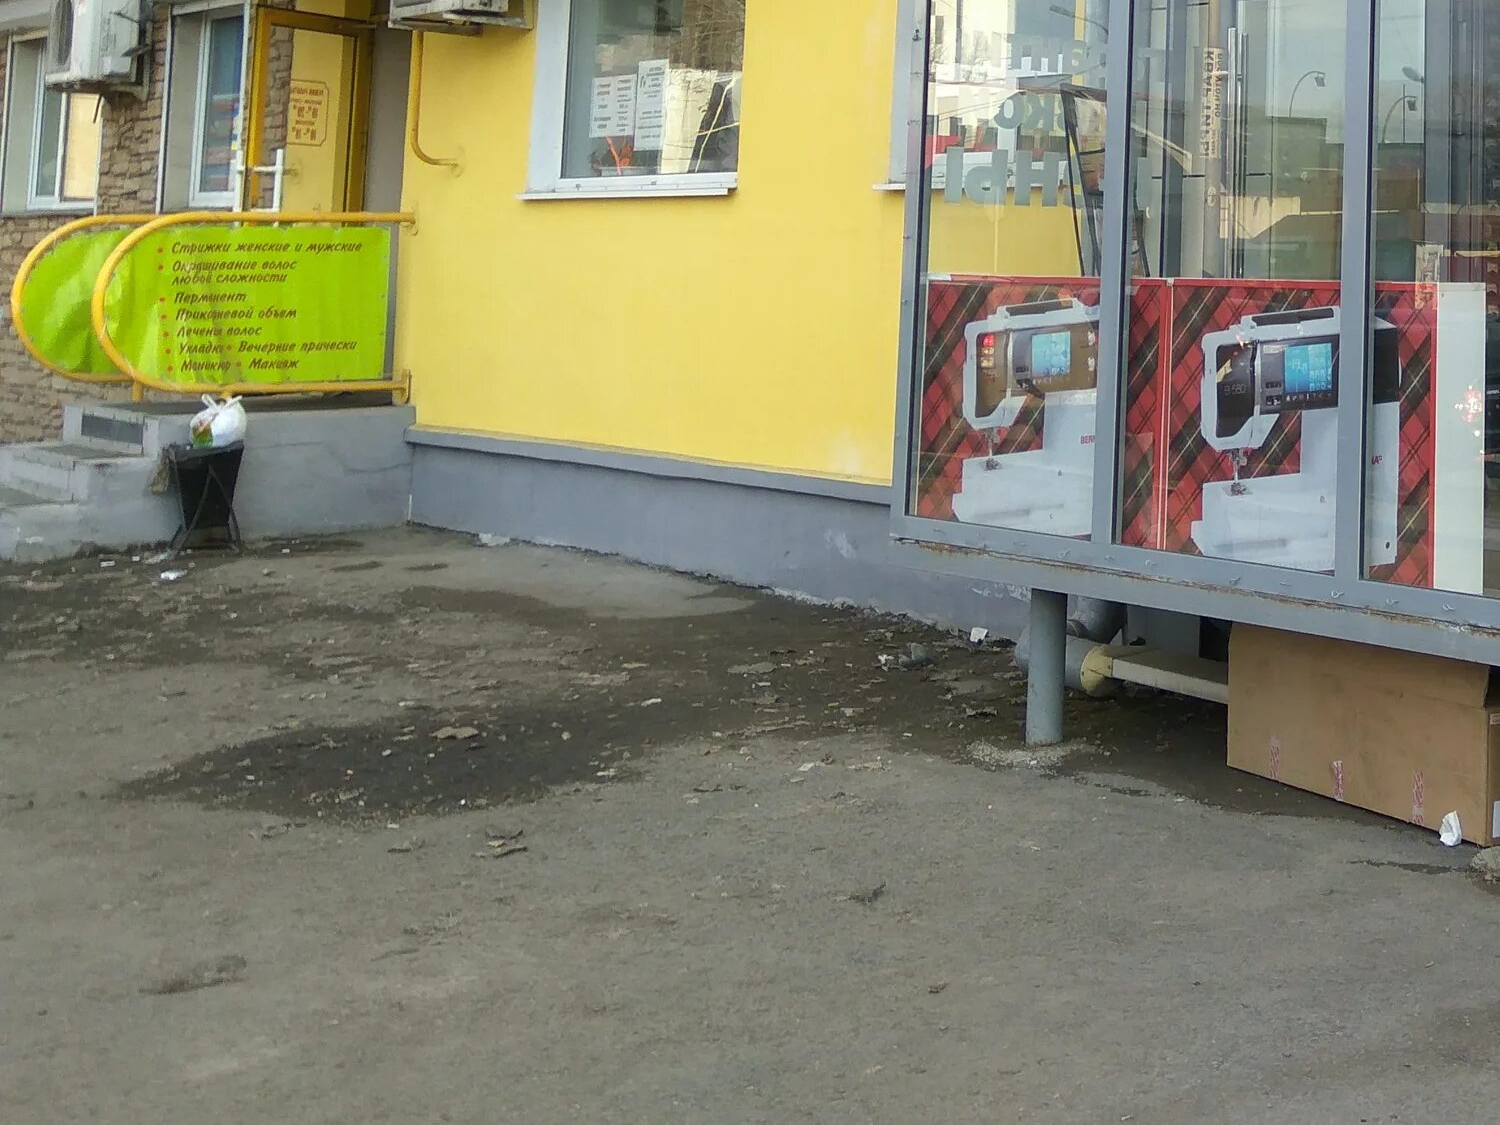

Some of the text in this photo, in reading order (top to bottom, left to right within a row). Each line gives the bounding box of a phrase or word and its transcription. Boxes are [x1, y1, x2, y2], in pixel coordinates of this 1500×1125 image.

[171, 241, 363, 255] Стрижки женские и мужские
[261, 261, 298, 270] волос
[216, 273, 288, 284] сложности
[226, 326, 263, 336] волос
[238, 340, 297, 355] Вечерние
[300, 341, 358, 355] прически
[248, 357, 300, 371] Макияж
